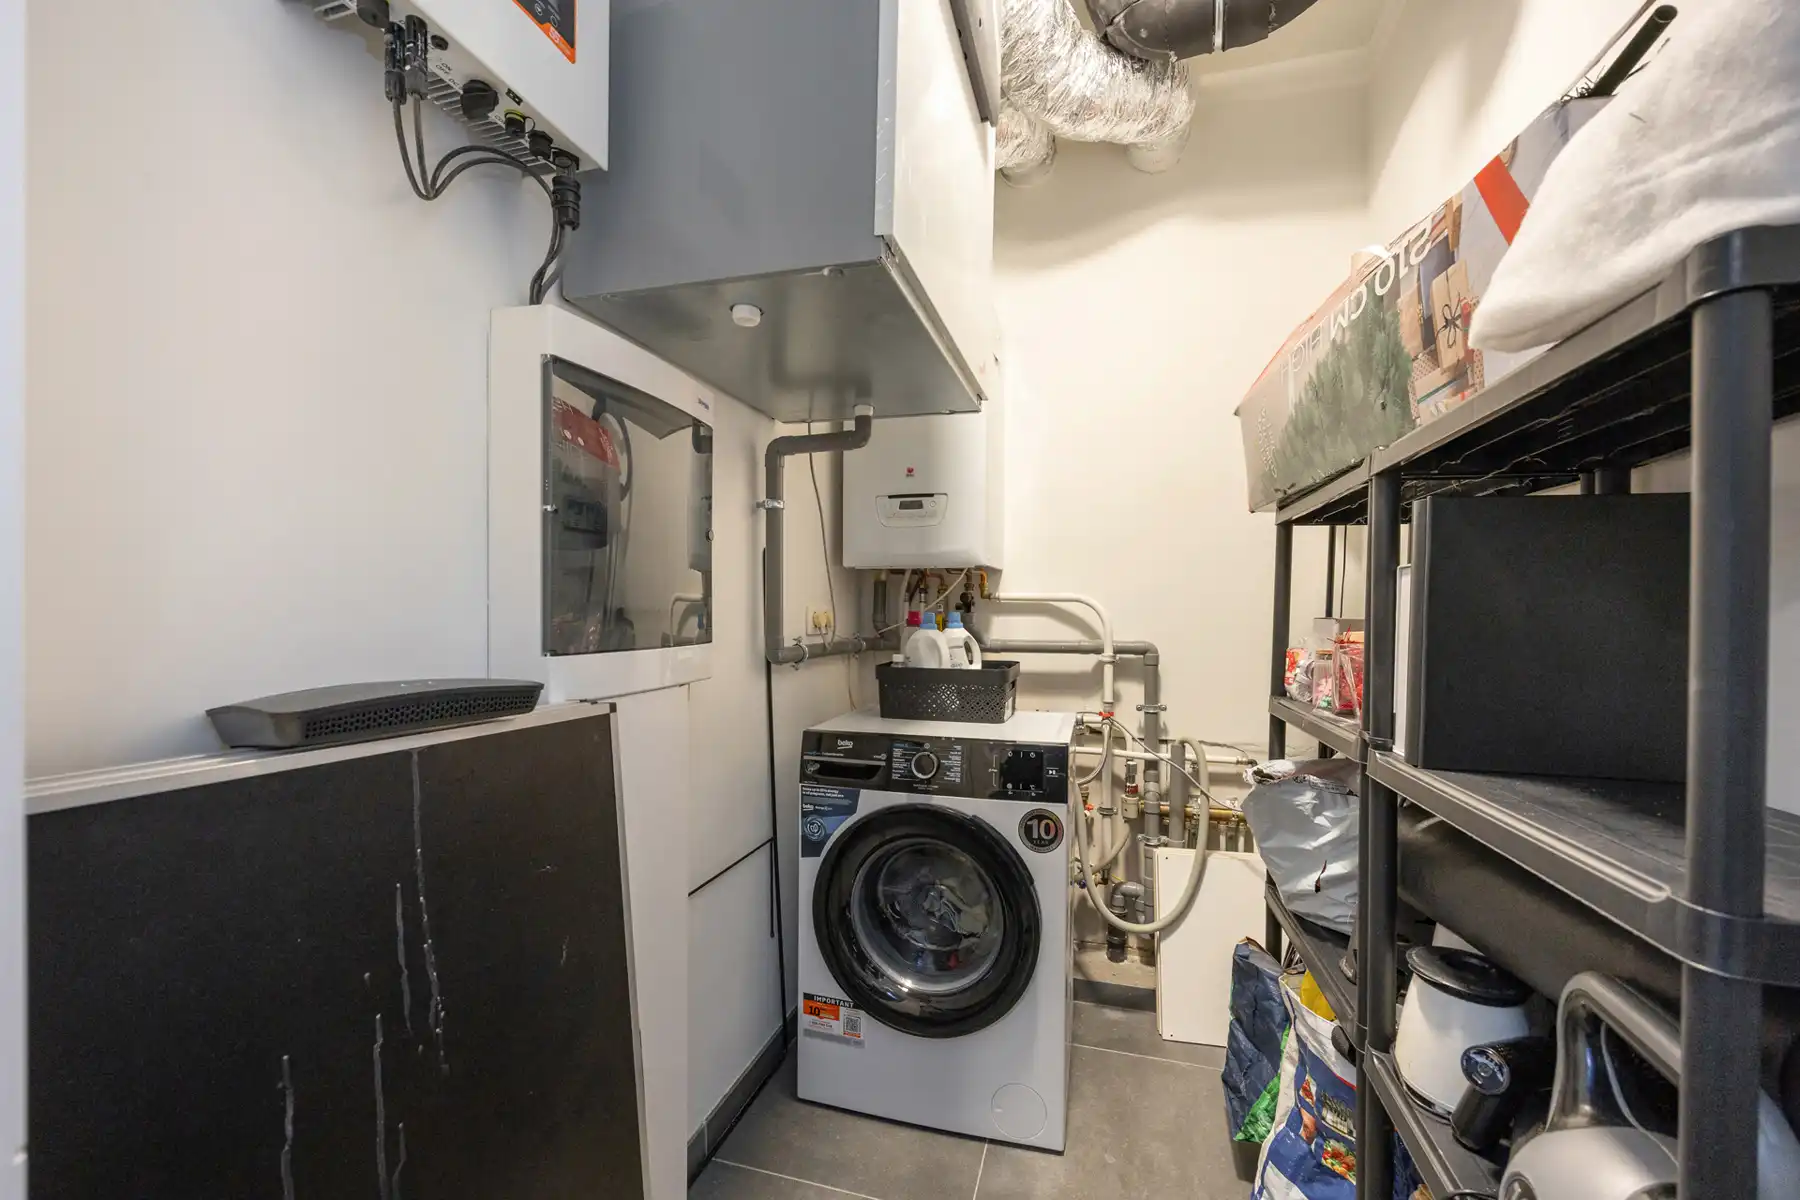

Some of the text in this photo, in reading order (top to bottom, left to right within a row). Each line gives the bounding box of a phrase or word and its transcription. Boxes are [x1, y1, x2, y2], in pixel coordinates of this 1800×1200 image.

[1329, 283, 1368, 341] CM
[837, 739, 854, 749] beko
[1027, 818, 1056, 840] 10
[813, 995, 855, 1008] IMPORTANT
[808, 1005, 821, 1017] 10
